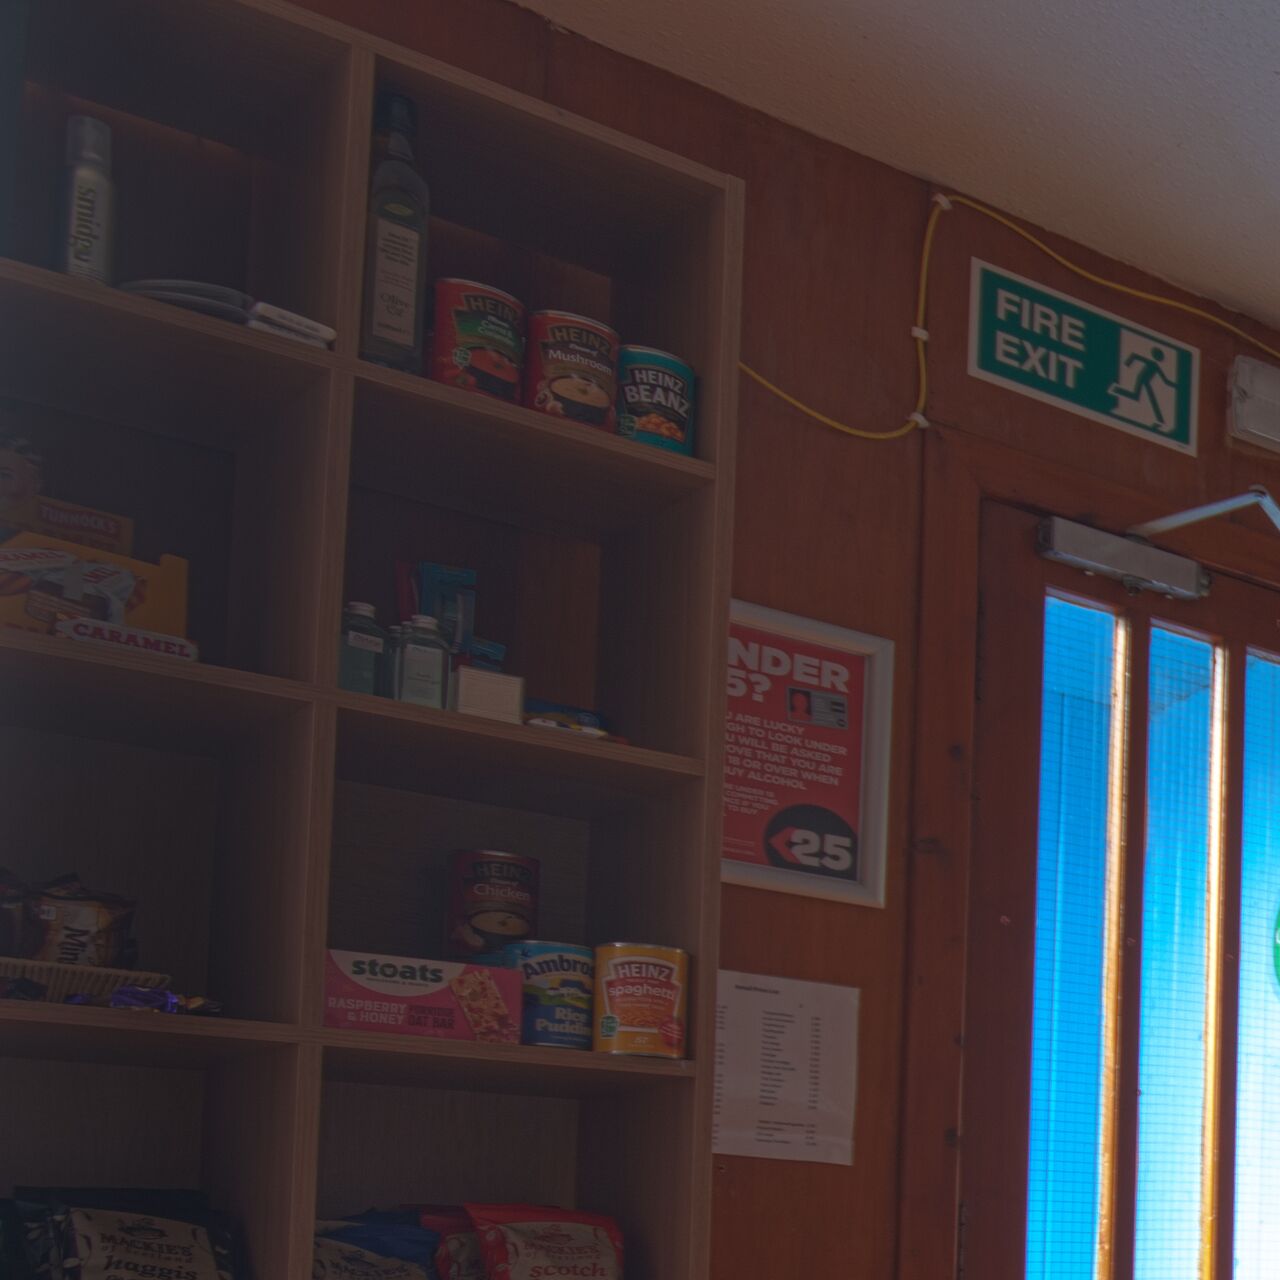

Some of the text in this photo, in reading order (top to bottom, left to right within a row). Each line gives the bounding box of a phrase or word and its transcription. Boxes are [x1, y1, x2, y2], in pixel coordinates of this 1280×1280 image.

[997, 288, 1086, 351] FIRE
[553, 327, 611, 352] HEINZ
[548, 349, 612, 375] Mushroom
[995, 330, 1085, 389] EXIT
[634, 369, 684, 393] HEINZ
[624, 385, 691, 418] BEANZ
[73, 623, 191, 658] CARAMEL
[728, 637, 850, 693] NDER
[726, 668, 772, 703] 5?
[735, 713, 804, 736] ARE LUCKY
[738, 735, 832, 763] WILL BE ASKED
[749, 727, 848, 756] TO LOOK UNDER
[727, 744, 844, 777] OVE THAT YOU ARE
[728, 755, 839, 786] 18 OR OVER WHEN
[748, 771, 807, 791] ALCOHOL
[473, 883, 531, 902] Chicken
[352, 958, 443, 984] stoats
[522, 954, 594, 980] Ambros
[617, 964, 670, 982] HEINZ
[328, 997, 407, 1015] RASPBERRY
[347, 1010, 405, 1026] & HONEY
[536, 1017, 593, 1037] Puddin
[104, 1256, 198, 1280] haggis
[530, 1262, 607, 1279] scotch
